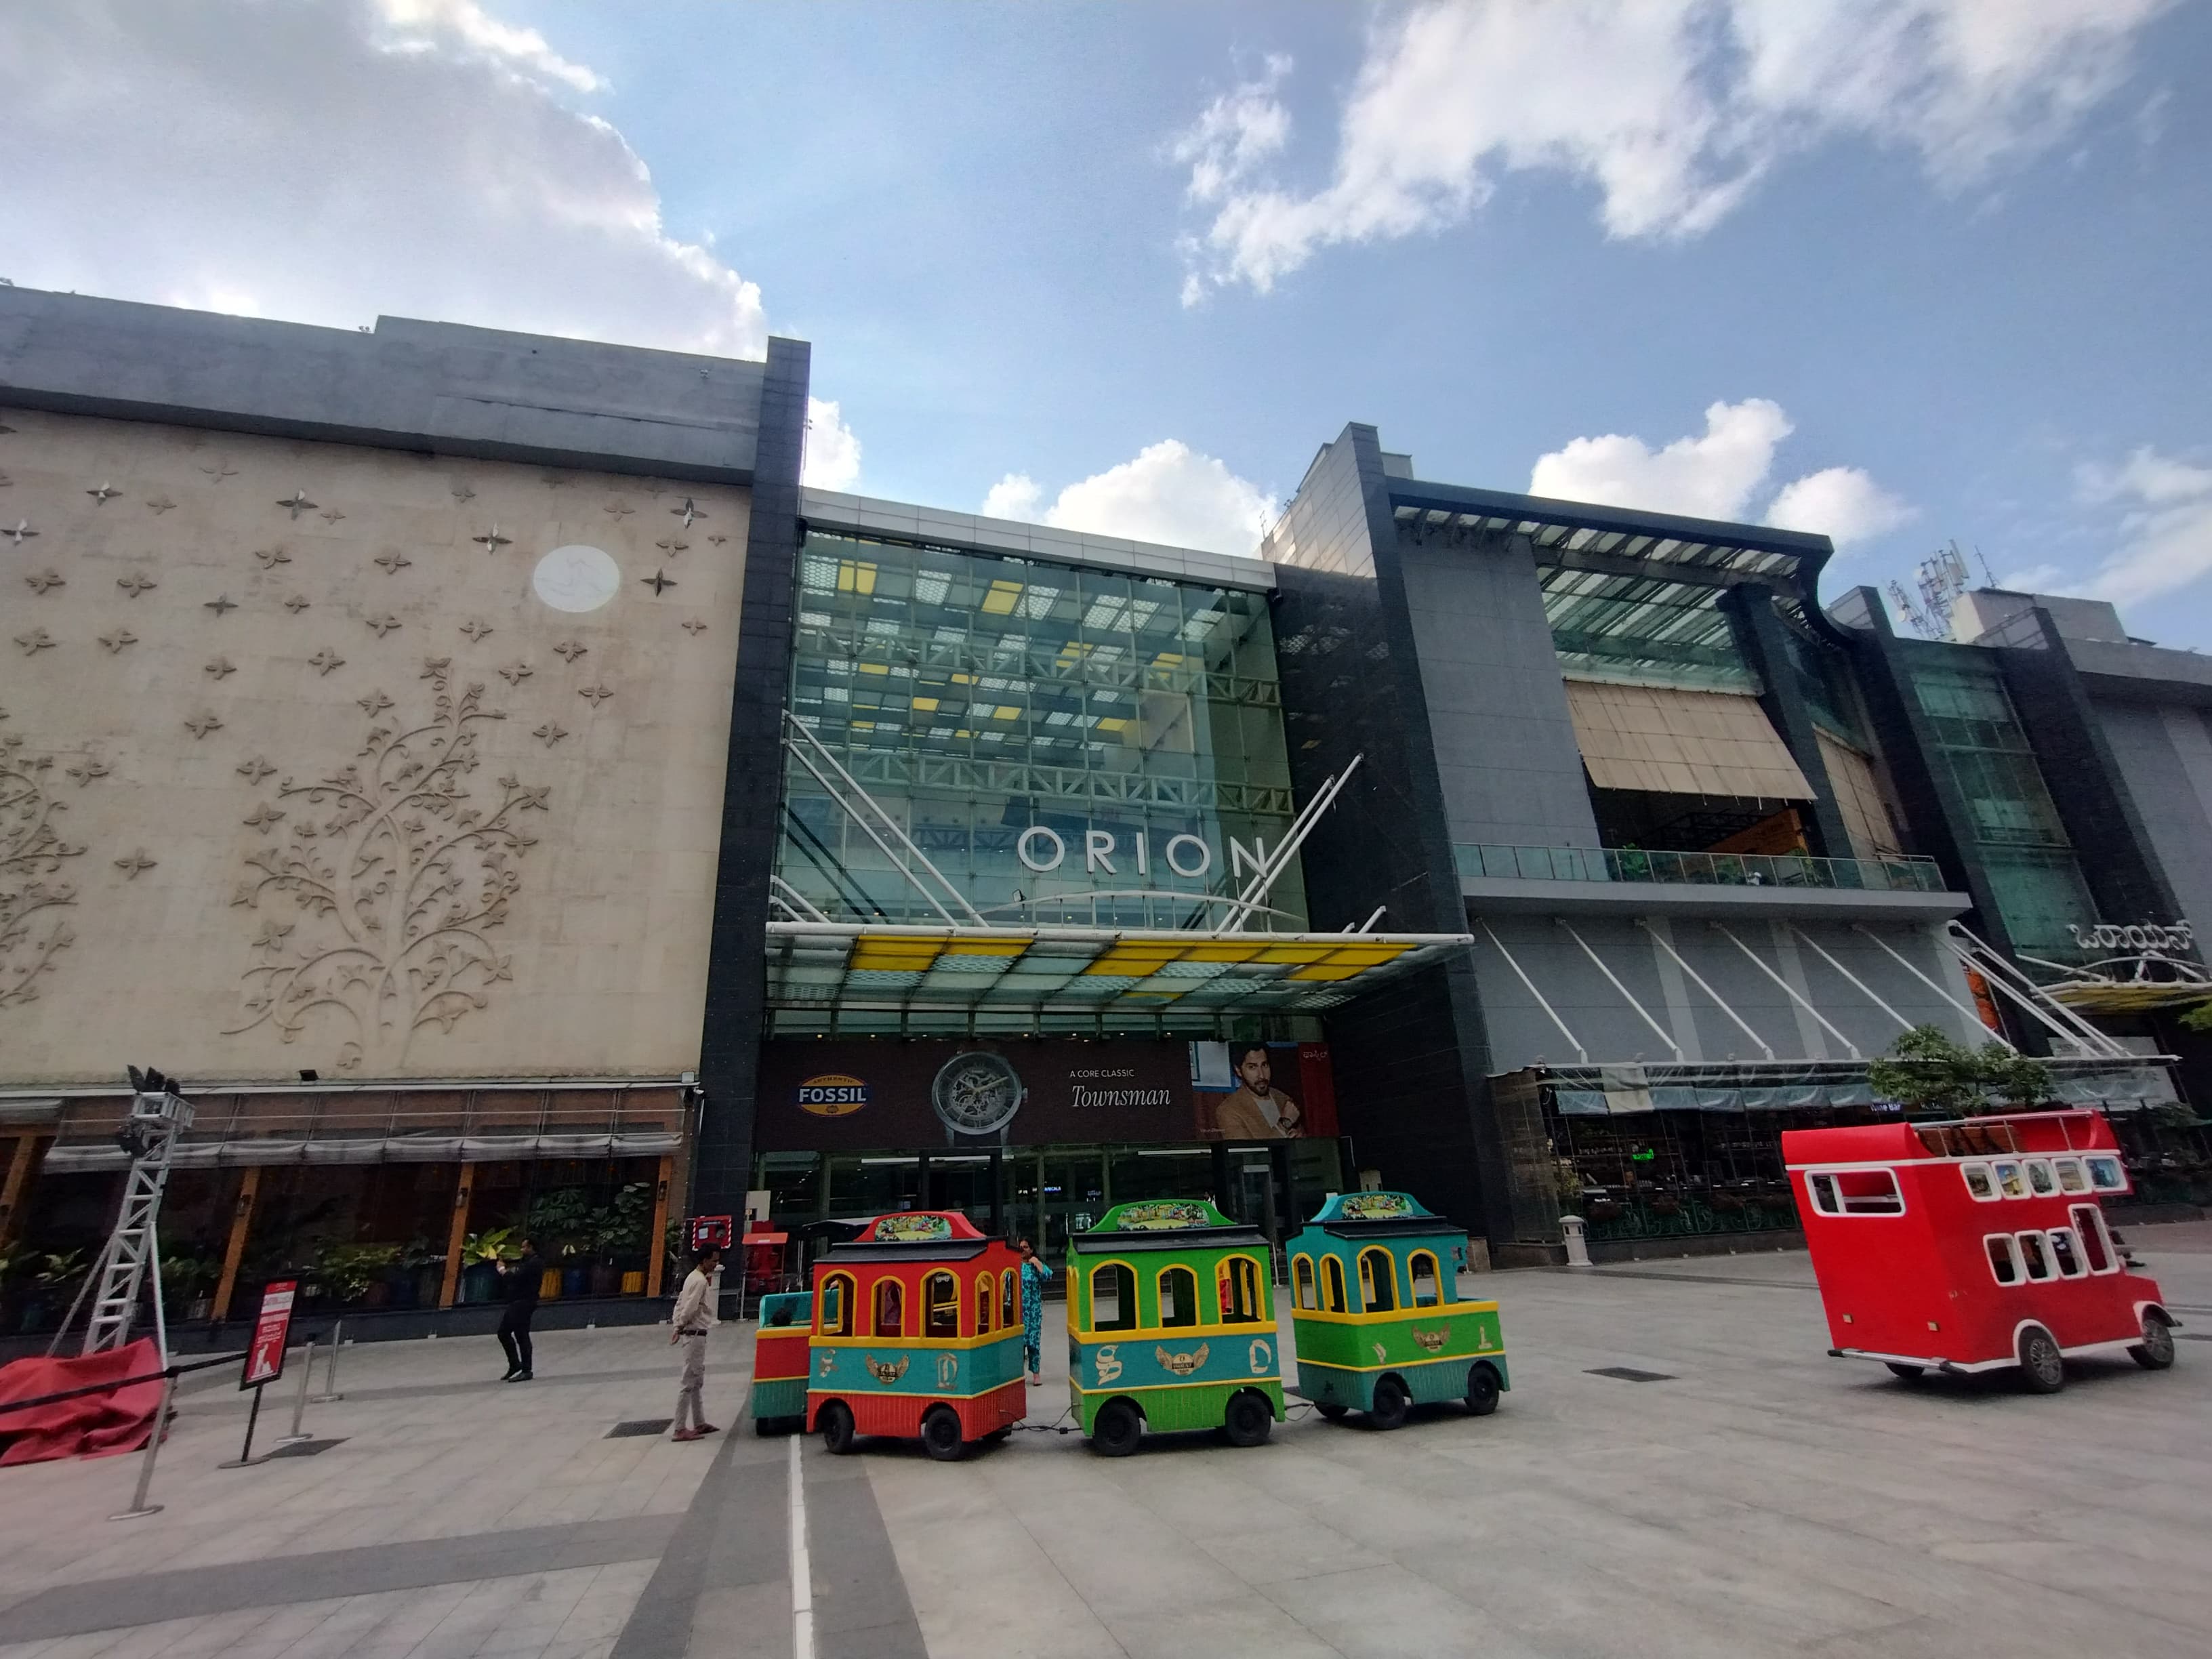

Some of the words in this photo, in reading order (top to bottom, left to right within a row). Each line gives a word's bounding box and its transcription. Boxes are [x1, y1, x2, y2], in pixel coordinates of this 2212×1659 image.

[1018, 826, 1267, 879] ORION
[799, 1088, 867, 1103] FOSSIL
[1072, 1085, 1171, 1107] Townsman
